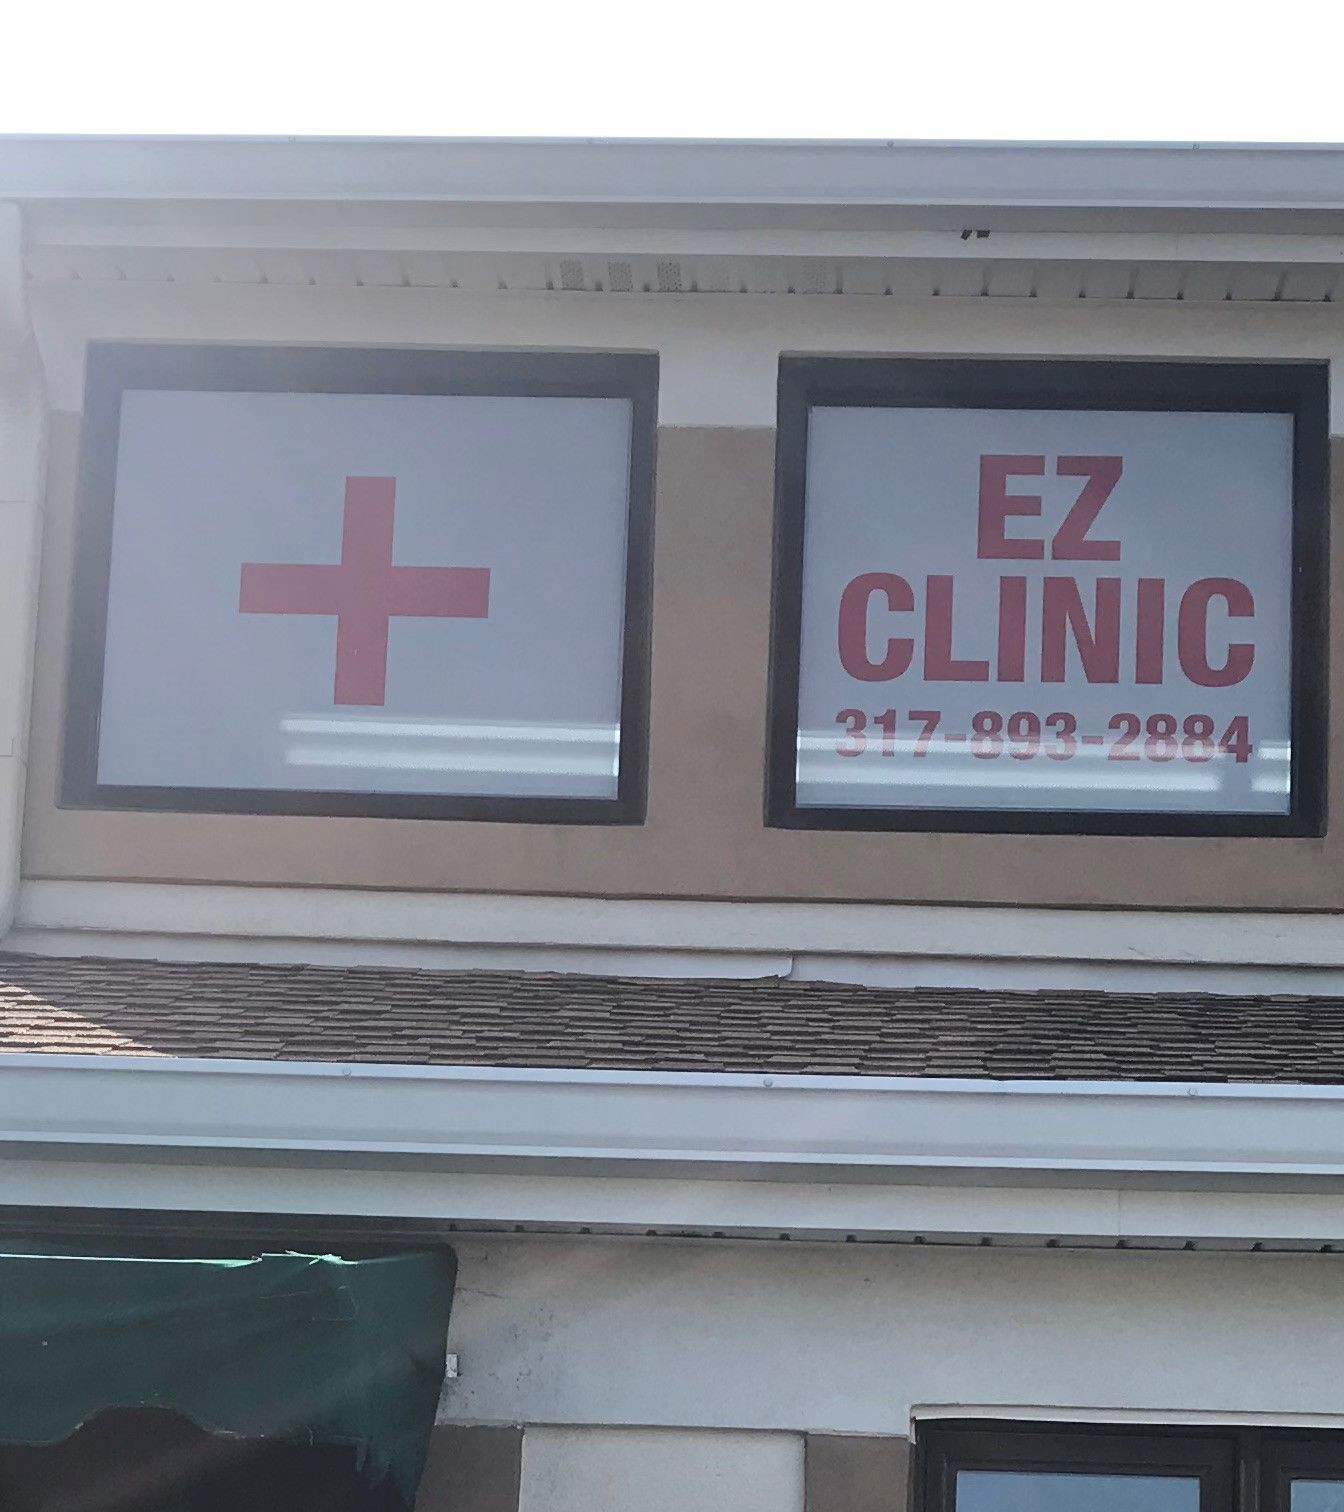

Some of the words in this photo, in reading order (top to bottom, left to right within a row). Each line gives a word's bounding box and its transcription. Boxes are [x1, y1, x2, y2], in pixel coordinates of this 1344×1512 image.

[977, 453, 1124, 562] EZ
[837, 571, 1256, 688] CLINIC
[834, 708, 1254, 764] 317-893-2884
